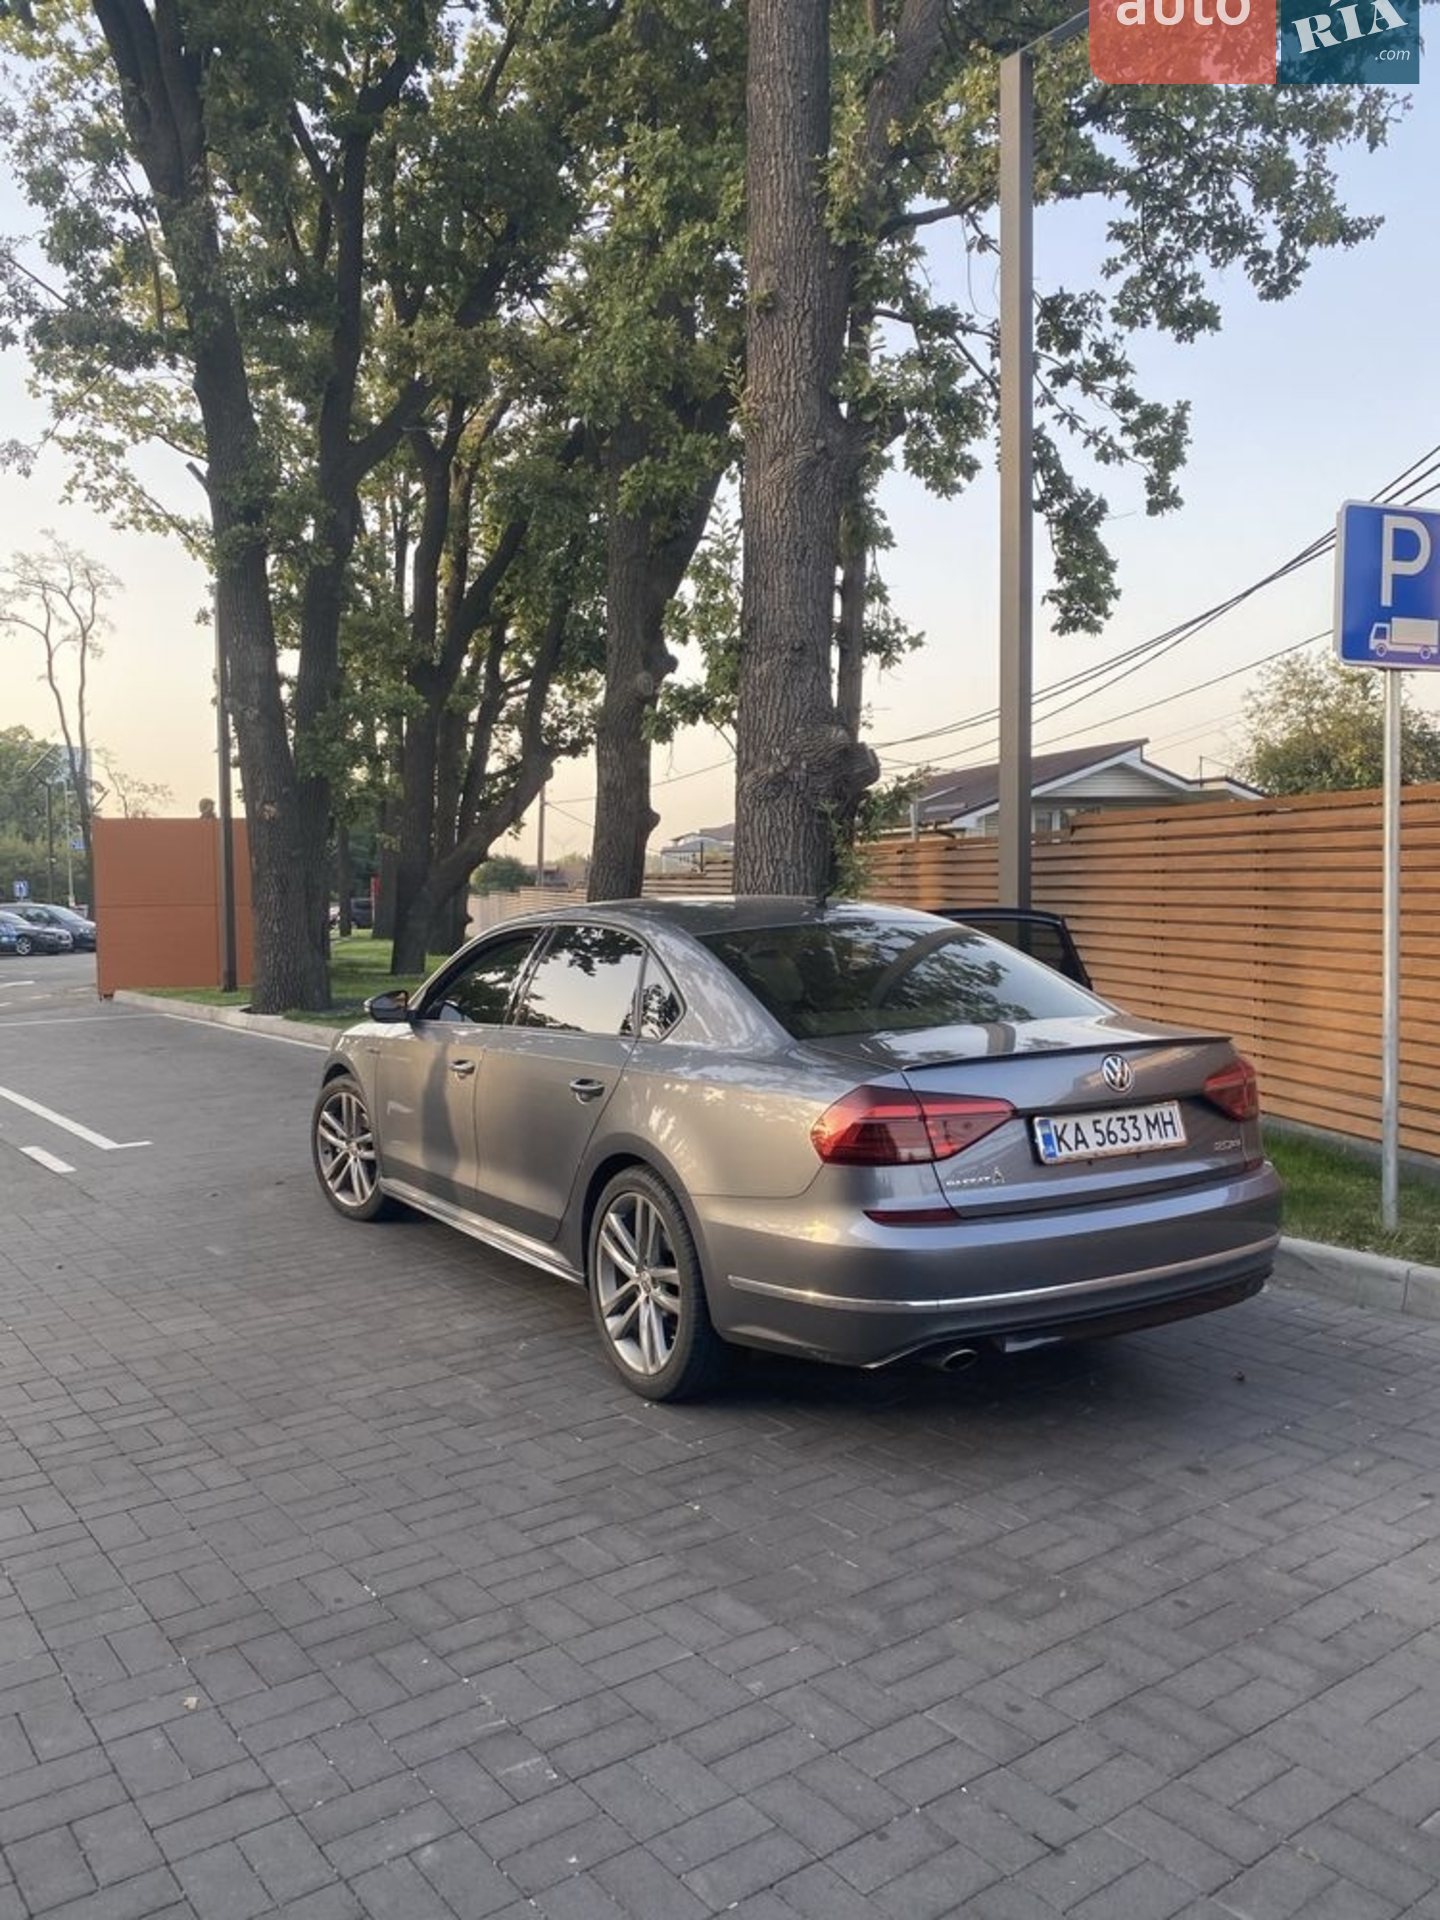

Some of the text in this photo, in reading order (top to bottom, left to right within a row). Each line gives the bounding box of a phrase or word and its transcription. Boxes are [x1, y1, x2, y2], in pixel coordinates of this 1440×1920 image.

[1380, 513, 1432, 608] P
[1055, 1122, 1089, 1152] KA
[1092, 1115, 1142, 1147] 5633
[1144, 1111, 1177, 1140] MH
